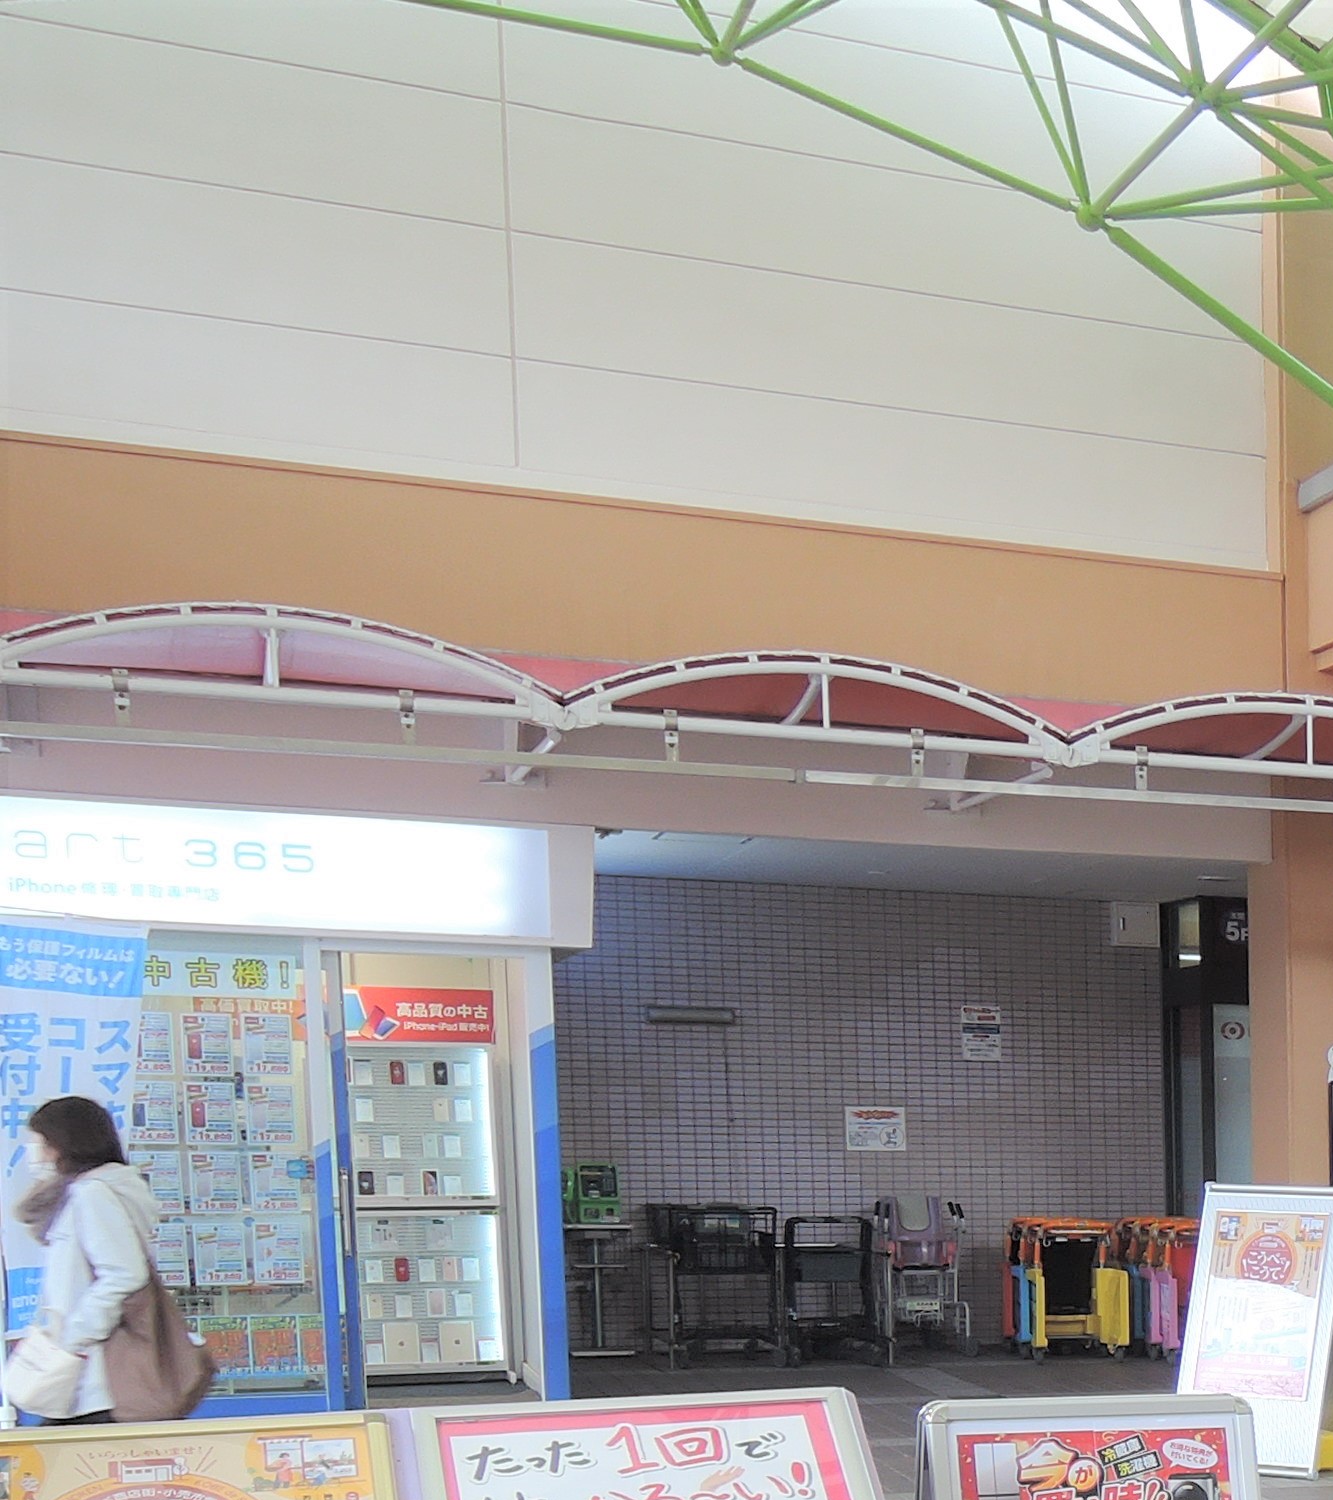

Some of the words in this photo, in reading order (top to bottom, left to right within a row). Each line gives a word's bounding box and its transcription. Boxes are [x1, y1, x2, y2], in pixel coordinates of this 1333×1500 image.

[184, 839, 314, 872] 365
[395, 1002, 489, 1020] 高品質の中古
[1018, 1439, 1099, 1492] 今が
